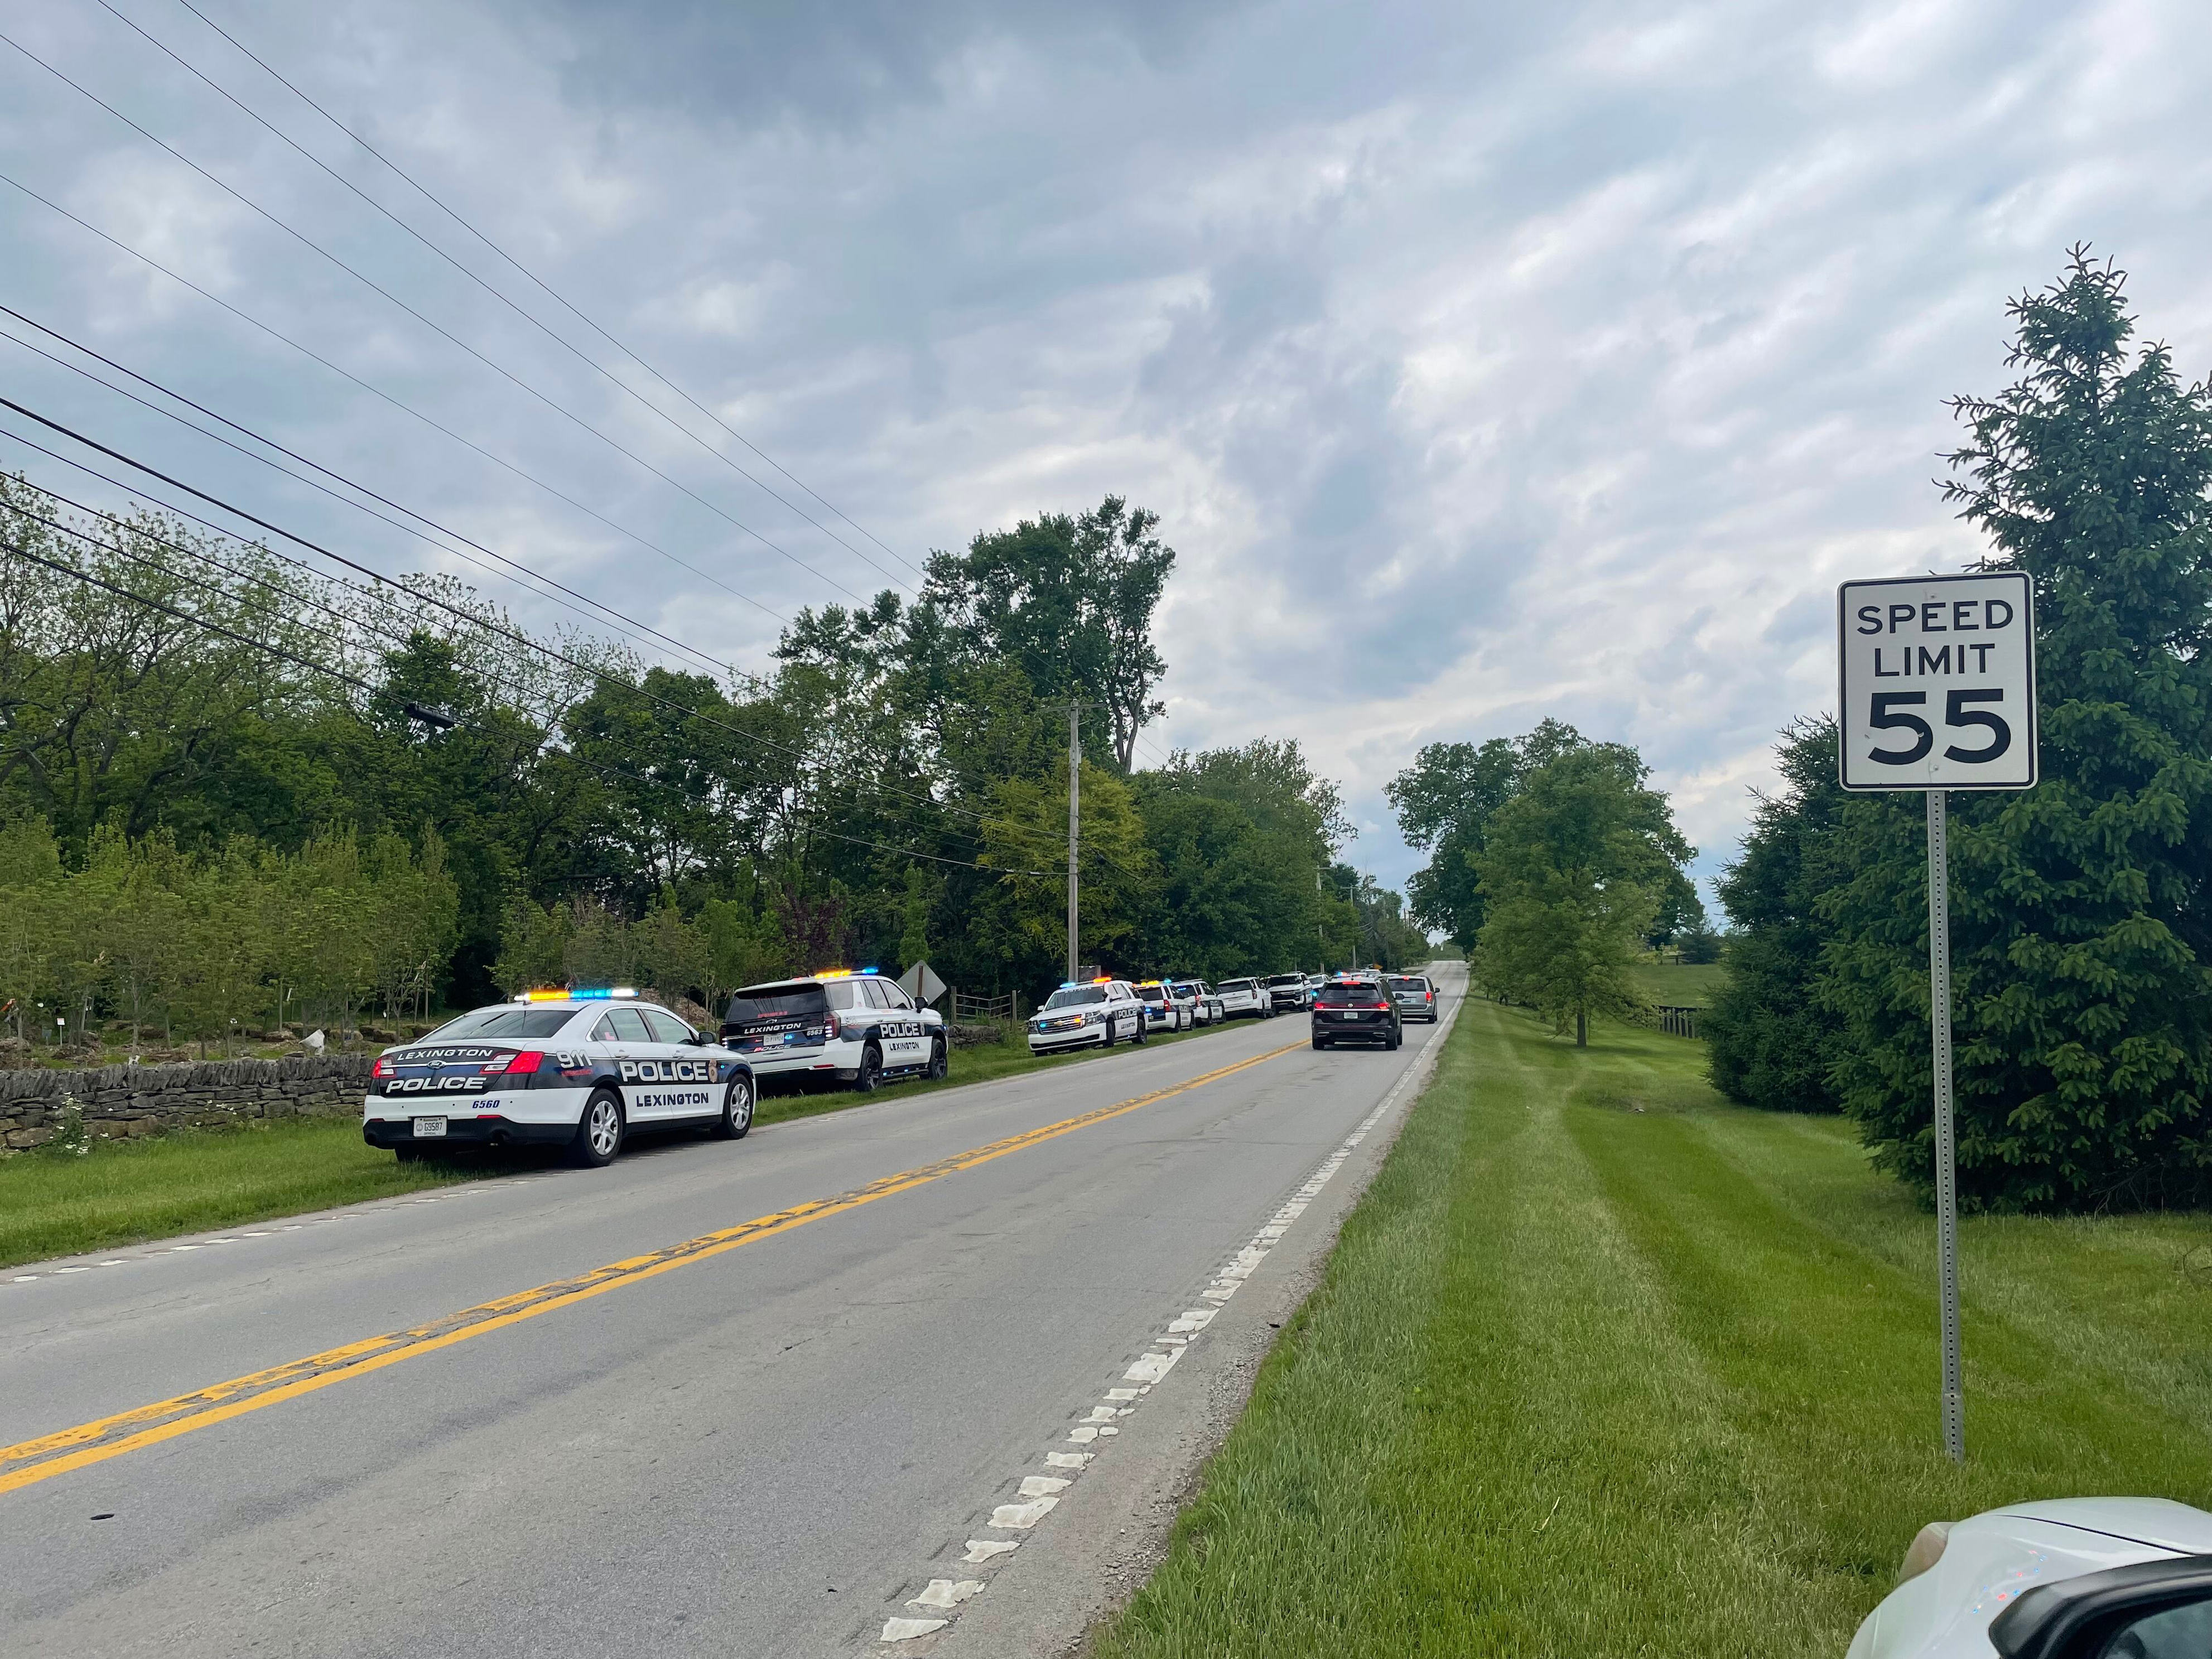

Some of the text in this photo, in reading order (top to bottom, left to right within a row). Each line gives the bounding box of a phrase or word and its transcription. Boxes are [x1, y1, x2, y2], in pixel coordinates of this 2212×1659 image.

[1857, 600, 2013, 635] SPEED
[1874, 643, 1995, 677] LIMIT
[1868, 688, 2011, 765] 55
[1118, 1008, 1137, 1019] POLICE
[744, 1023, 802, 1034] LEXINGTON
[879, 1023, 919, 1038] POLICE
[754, 1044, 792, 1053] POLICE
[889, 1042, 919, 1051] LEXINGTON
[397, 1049, 493, 1062] LEXINGTON
[556, 1049, 593, 1068] 911
[619, 1061, 709, 1082] POLICE
[385, 1077, 487, 1093] POLICE
[472, 1100, 500, 1109] 6560
[636, 1092, 709, 1107] LEXINGTON
[424, 1122, 442, 1131] G9587
